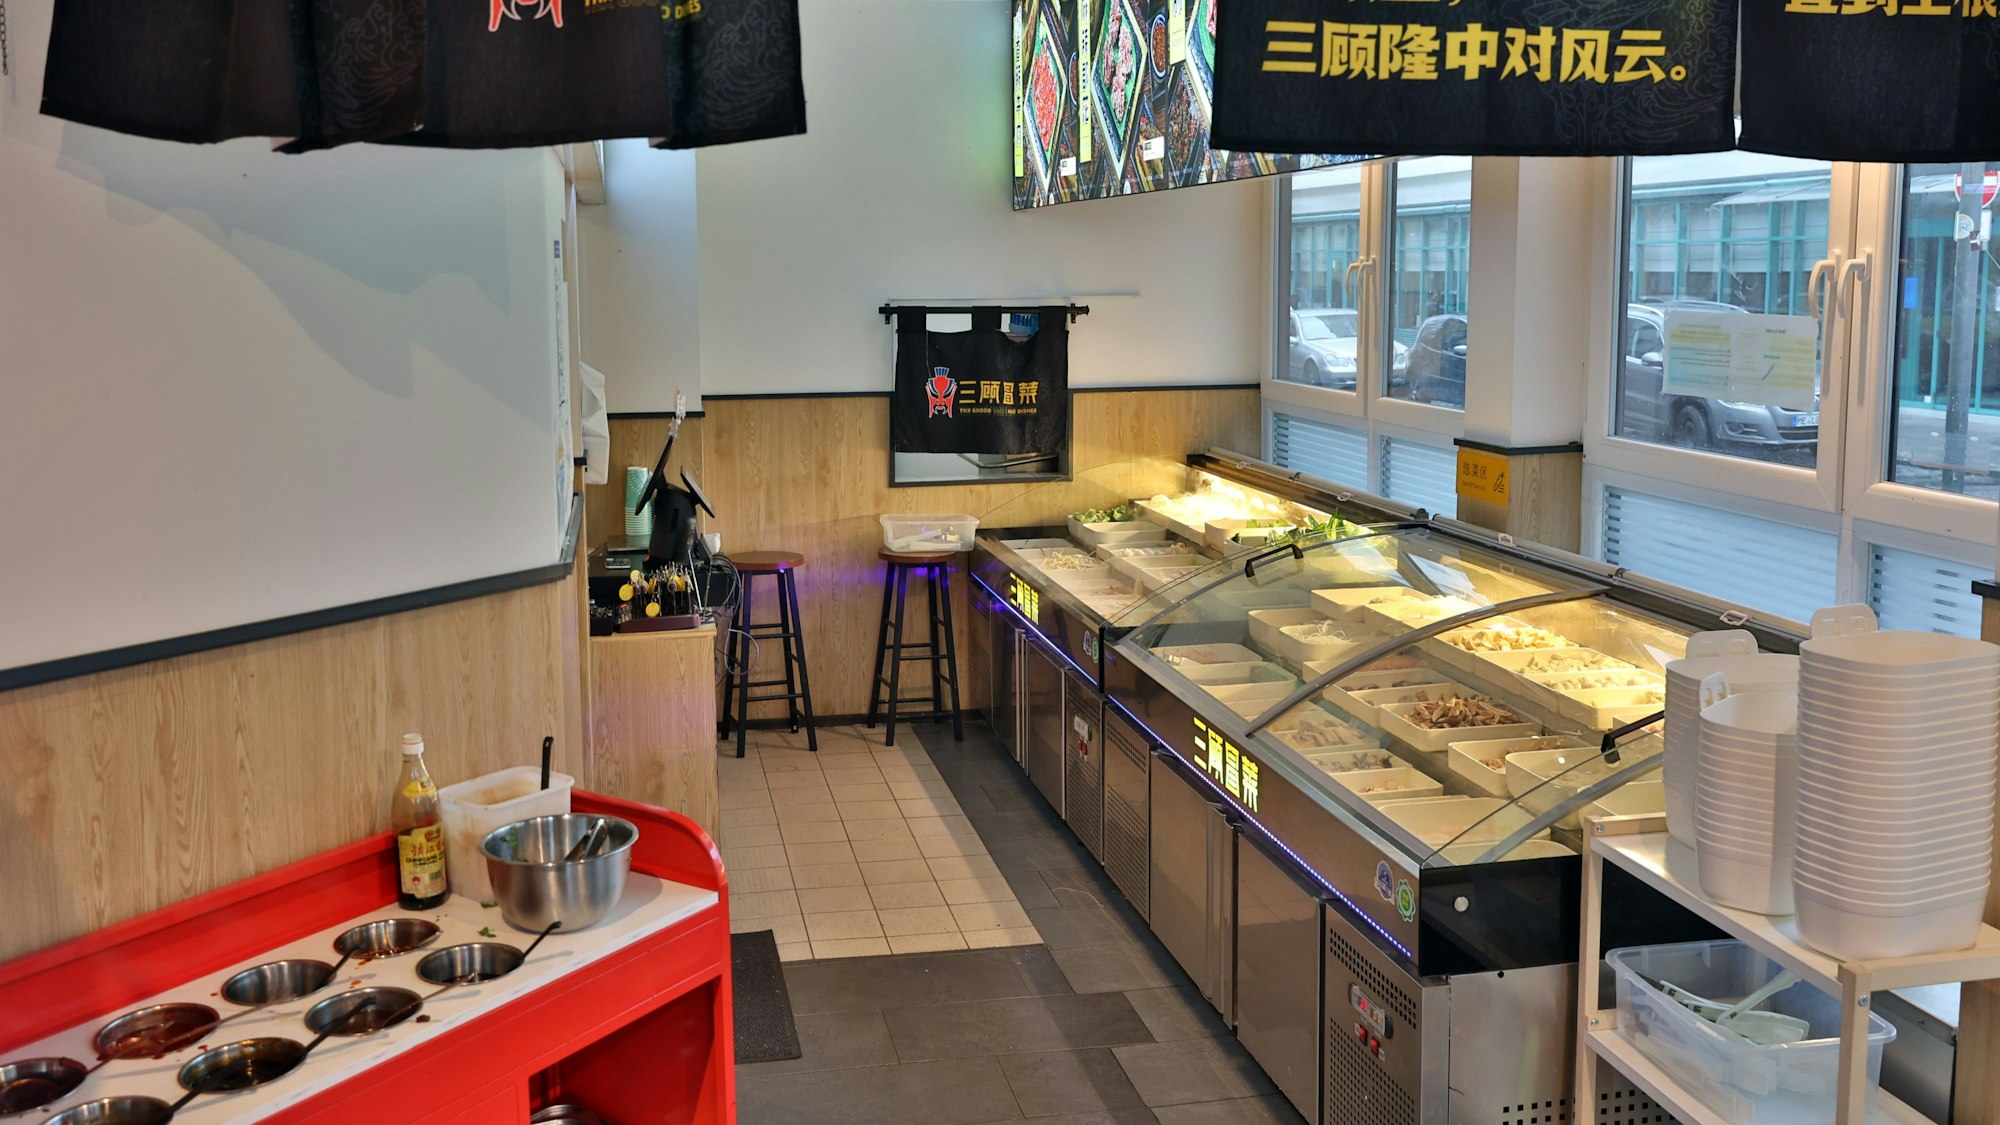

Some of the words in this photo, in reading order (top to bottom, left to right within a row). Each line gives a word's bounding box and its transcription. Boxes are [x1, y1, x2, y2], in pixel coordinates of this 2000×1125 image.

[1261, 20, 1687, 84] 三顾隆中对风云。
[959, 380, 1039, 405] 三顾冒菜
[1193, 716, 1259, 813] 三顾冒菜
